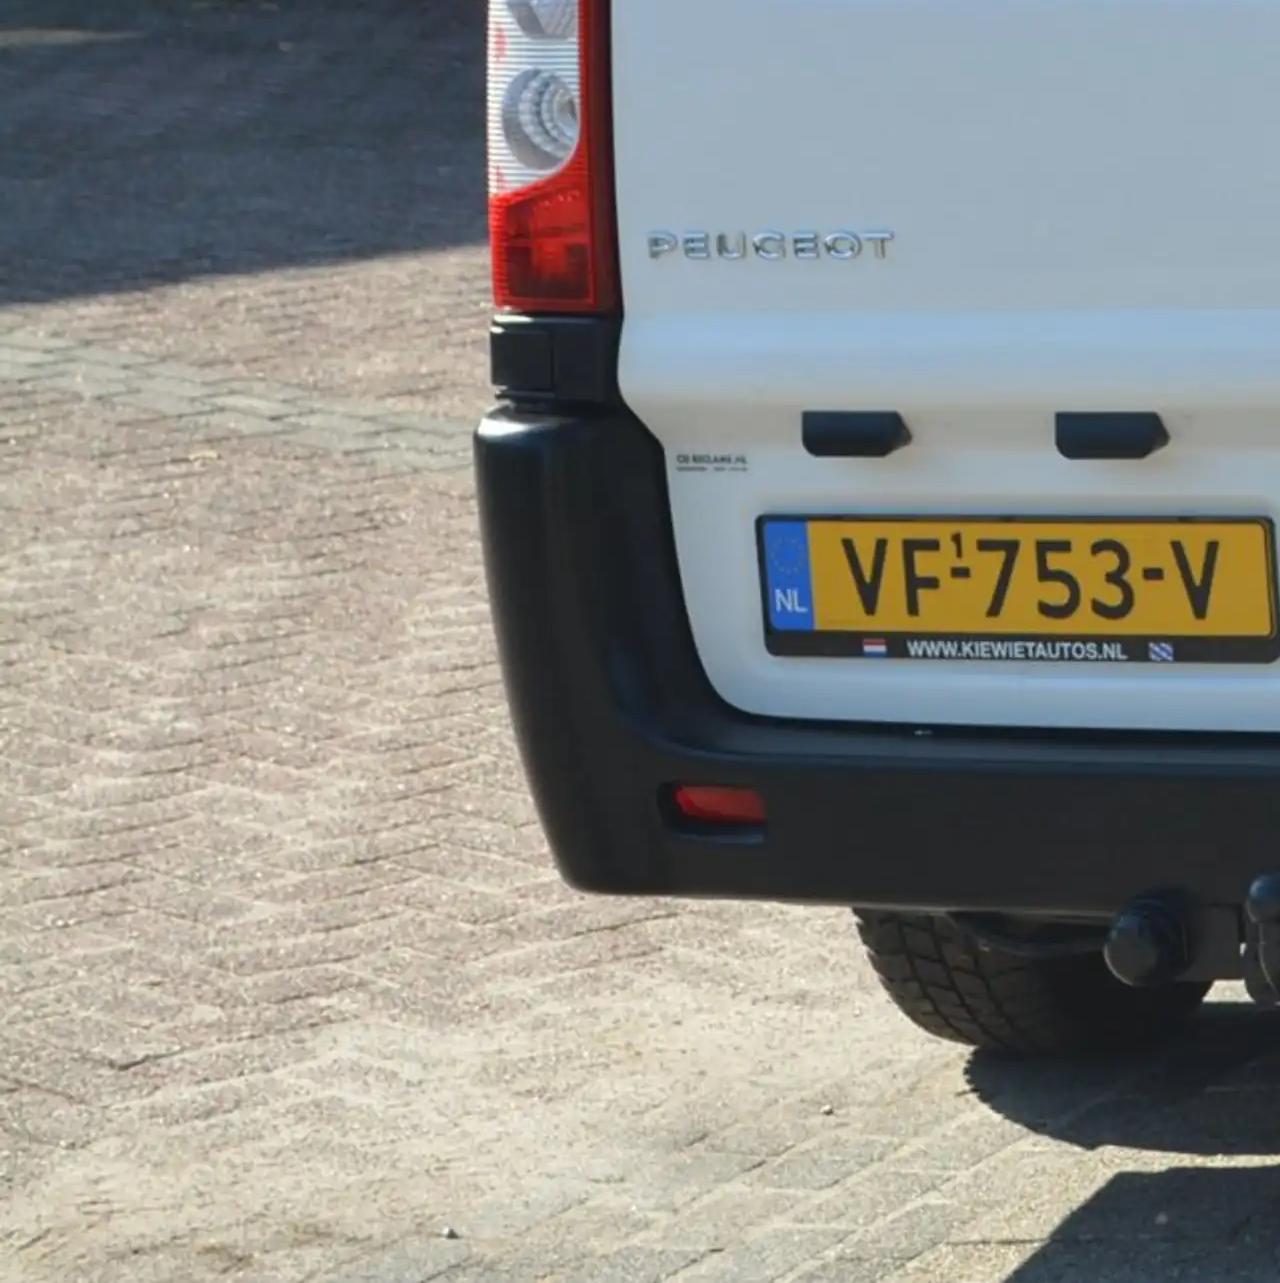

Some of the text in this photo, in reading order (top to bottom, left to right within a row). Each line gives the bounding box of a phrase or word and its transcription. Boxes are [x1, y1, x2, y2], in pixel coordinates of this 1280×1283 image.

[647, 230, 894, 261] PEUGEOT
[774, 588, 808, 613] NL
[907, 640, 1128, 661] WWW.KIEWIETAUTOS.NL
